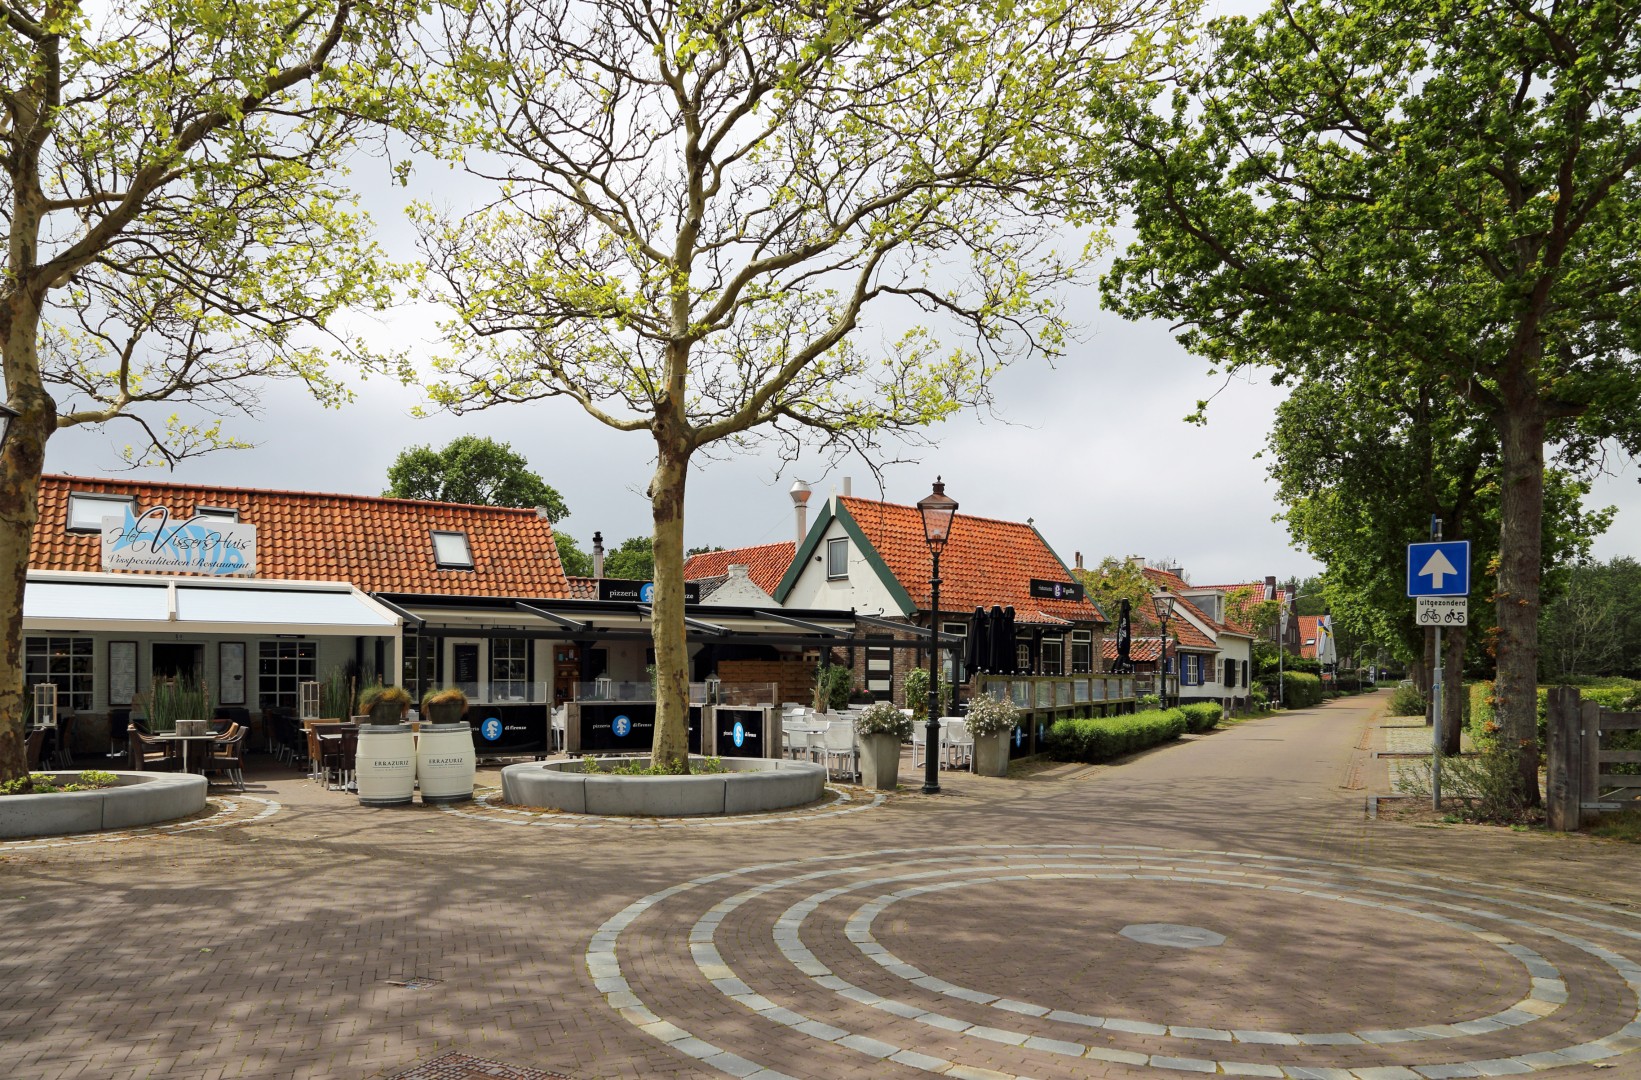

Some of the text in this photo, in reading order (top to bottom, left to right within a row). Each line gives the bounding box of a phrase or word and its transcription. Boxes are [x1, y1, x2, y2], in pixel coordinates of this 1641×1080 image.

[106, 525, 152, 552] Het
[107, 554, 250, 569] Visspecialiteiten Restaurant
[609, 590, 638, 598] pizzeria
[1419, 599, 1466, 607] uitgezonderd
